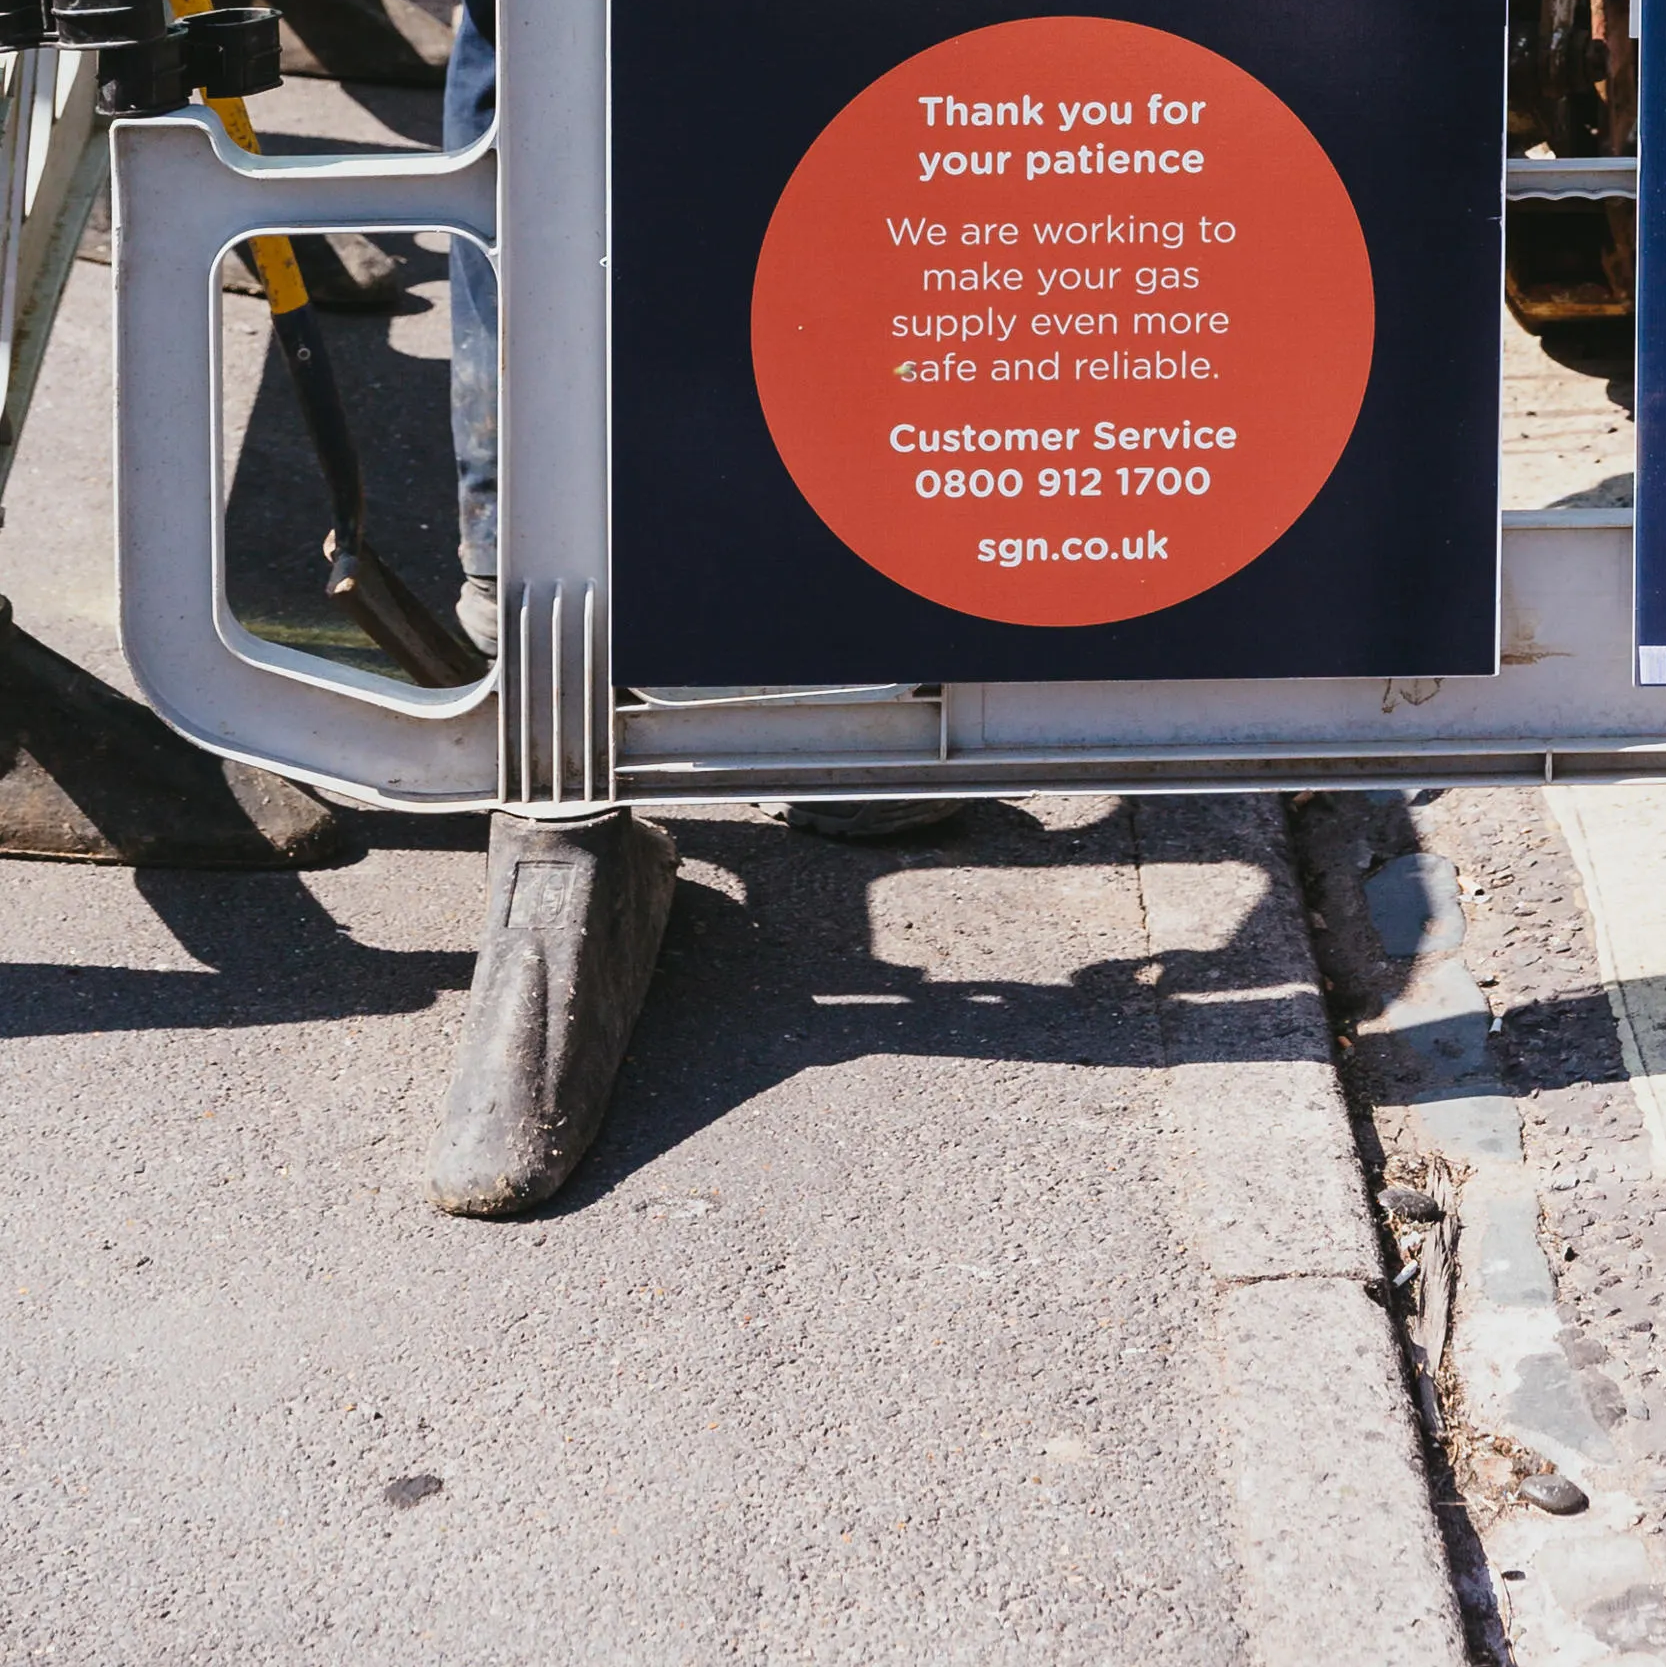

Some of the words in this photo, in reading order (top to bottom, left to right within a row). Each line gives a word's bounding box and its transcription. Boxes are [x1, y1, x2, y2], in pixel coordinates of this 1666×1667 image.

[918, 94, 1044, 127] Thank
[1058, 101, 1133, 132] you
[1147, 93, 1207, 125] for
[918, 151, 1012, 182] your
[1026, 142, 1205, 181] patience
[886, 217, 947, 246] We
[960, 222, 1019, 246] are
[1033, 214, 1184, 249] working
[1199, 216, 1236, 244] to
[923, 261, 1024, 291] make
[1037, 267, 1122, 296] your
[1135, 266, 1200, 295] gas
[892, 306, 1017, 342] supply
[1031, 313, 1118, 336] even
[1133, 312, 1229, 335] more
[898, 352, 977, 383] safe
[990, 351, 1060, 381] and
[1075, 350, 1219, 380] reliable.
[889, 423, 1081, 453] Customer
[1093, 419, 1237, 451] Service
[915, 468, 1024, 499] 0800
[1037, 467, 1102, 497] 912
[1115, 466, 1211, 496] 1700
[977, 529, 1169, 568] sgn.co.uk
